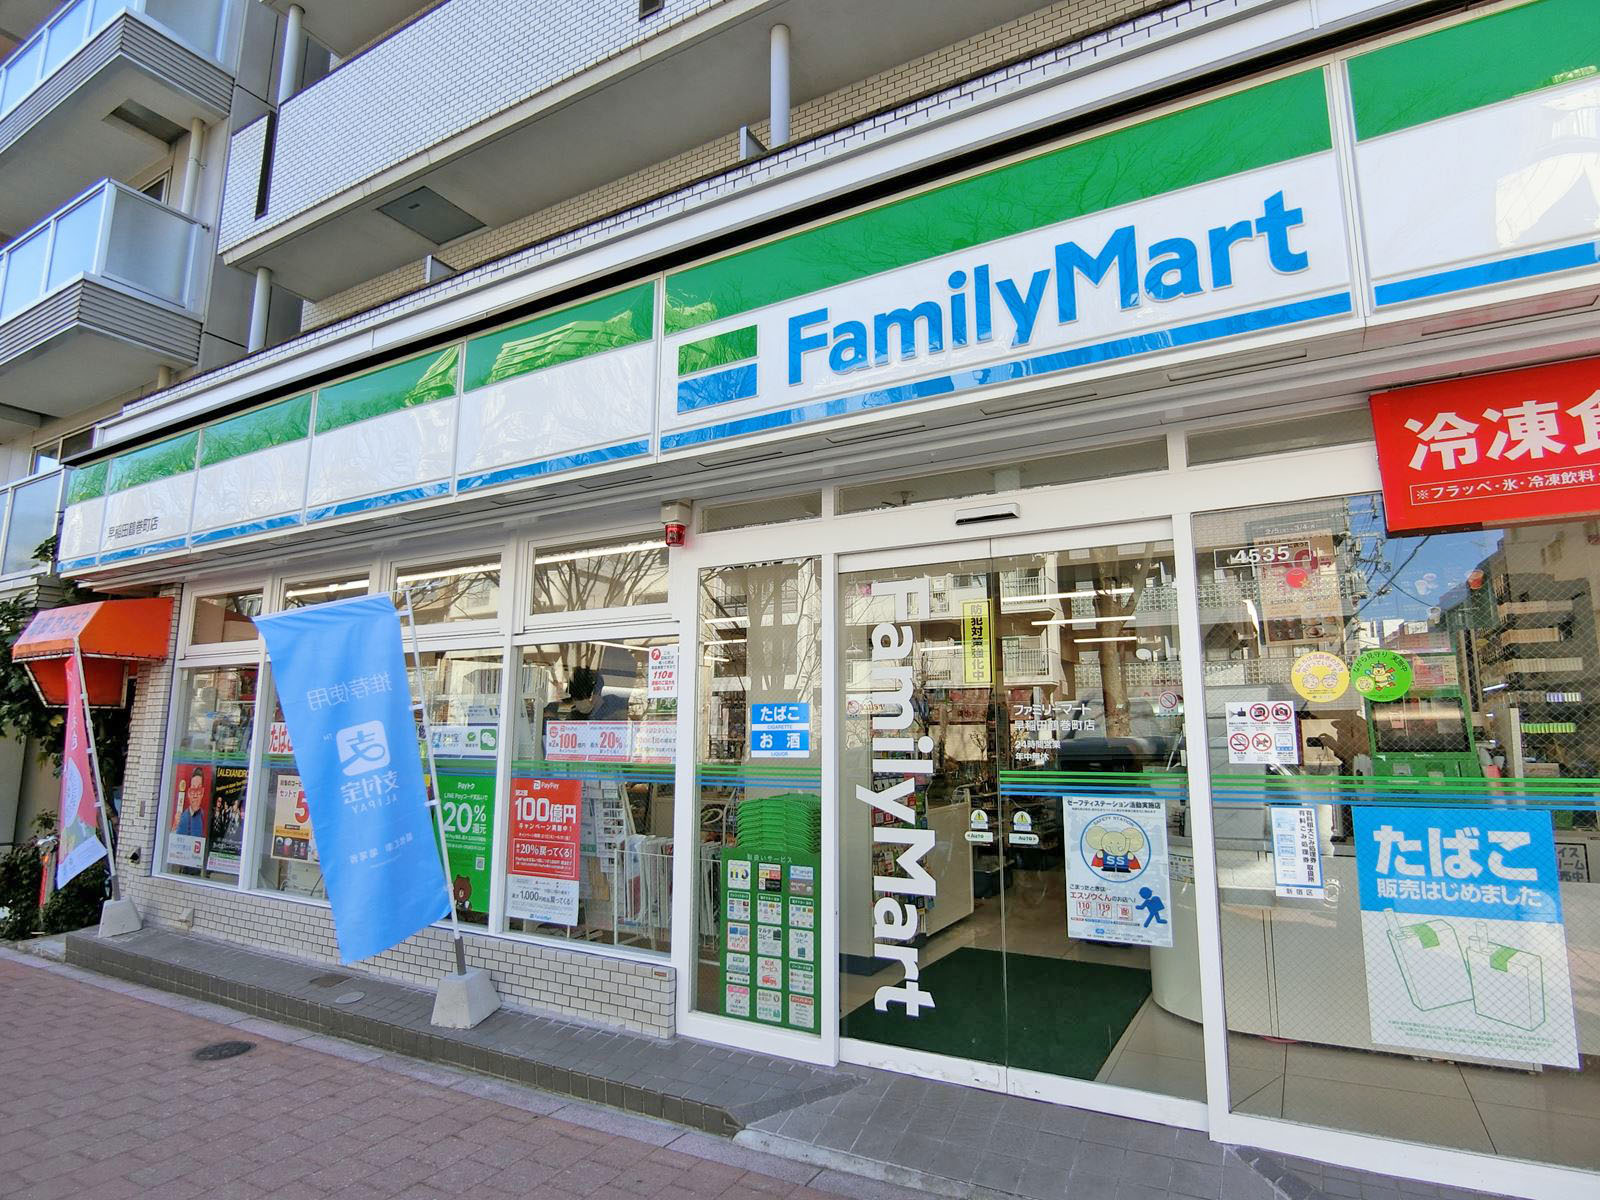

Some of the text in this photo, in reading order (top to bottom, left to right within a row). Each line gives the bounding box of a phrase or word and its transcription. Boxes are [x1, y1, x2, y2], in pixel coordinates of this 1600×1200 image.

[787, 189, 1311, 388] FamilyMart
[1233, 545, 1290, 563] 4535
[970, 603, 985, 681] 防犯対策強化中
[760, 705, 800, 722] たばこ
[1013, 703, 1092, 716] ファミリーマート
[1013, 719, 1096, 732] 早稲田鶴巻町店
[1015, 740, 1061, 749] 24時間営業
[1015, 752, 1050, 761] 年中無休
[856, 578, 937, 1018] FamilyMart
[515, 797, 577, 824] 100億円
[1106, 855, 1126, 866] SS
[1373, 824, 1539, 882] たばこ
[1376, 878, 1543, 908] 販売はじめました
[1078, 901, 1091, 910] 110
[1098, 903, 1111, 912] 119
